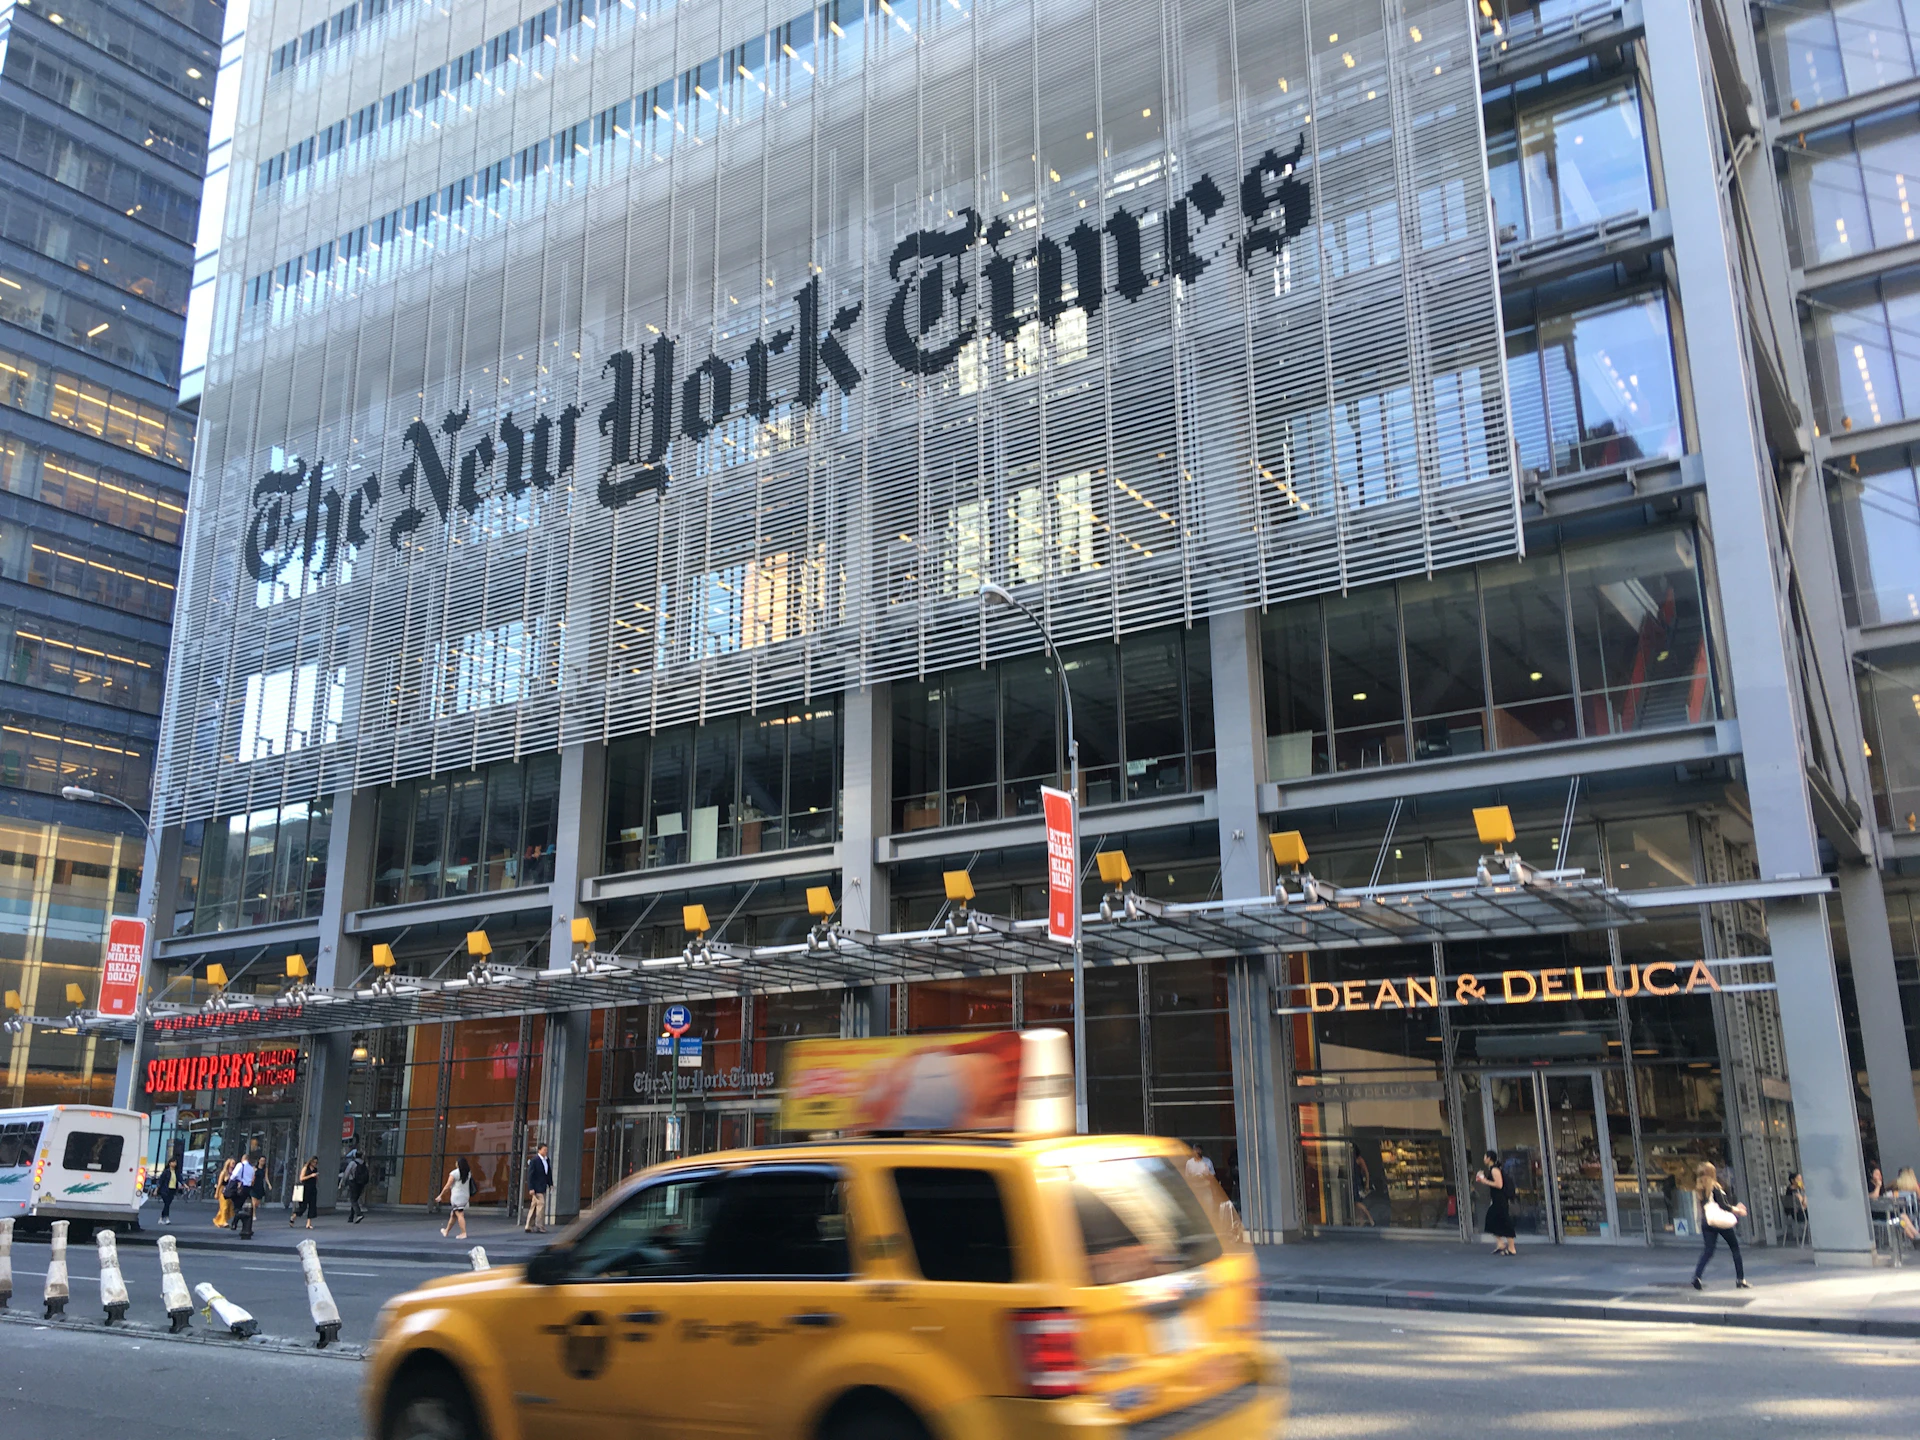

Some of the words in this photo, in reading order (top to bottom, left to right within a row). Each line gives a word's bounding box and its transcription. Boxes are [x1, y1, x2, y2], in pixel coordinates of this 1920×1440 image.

[244, 456, 381, 585] The
[390, 399, 586, 552] New
[600, 276, 863, 509] York
[885, 132, 1313, 376] Times
[107, 952, 141, 963] MIDLER
[110, 943, 141, 954] BETTE
[1309, 975, 1439, 1013] DEAN
[1455, 972, 1487, 1006] &
[1502, 959, 1722, 1004] DELUCA
[258, 1048, 297, 1067] QUALITY
[145, 1052, 255, 1094] SCHNIPPER'S
[256, 1068, 296, 1086] KITCHEN
[633, 1072, 659, 1094] The
[660, 1070, 690, 1094] Nw
[691, 1068, 727, 1095] York
[728, 1066, 775, 1088] Times
[1677, 1220, 1687, 1232] A
